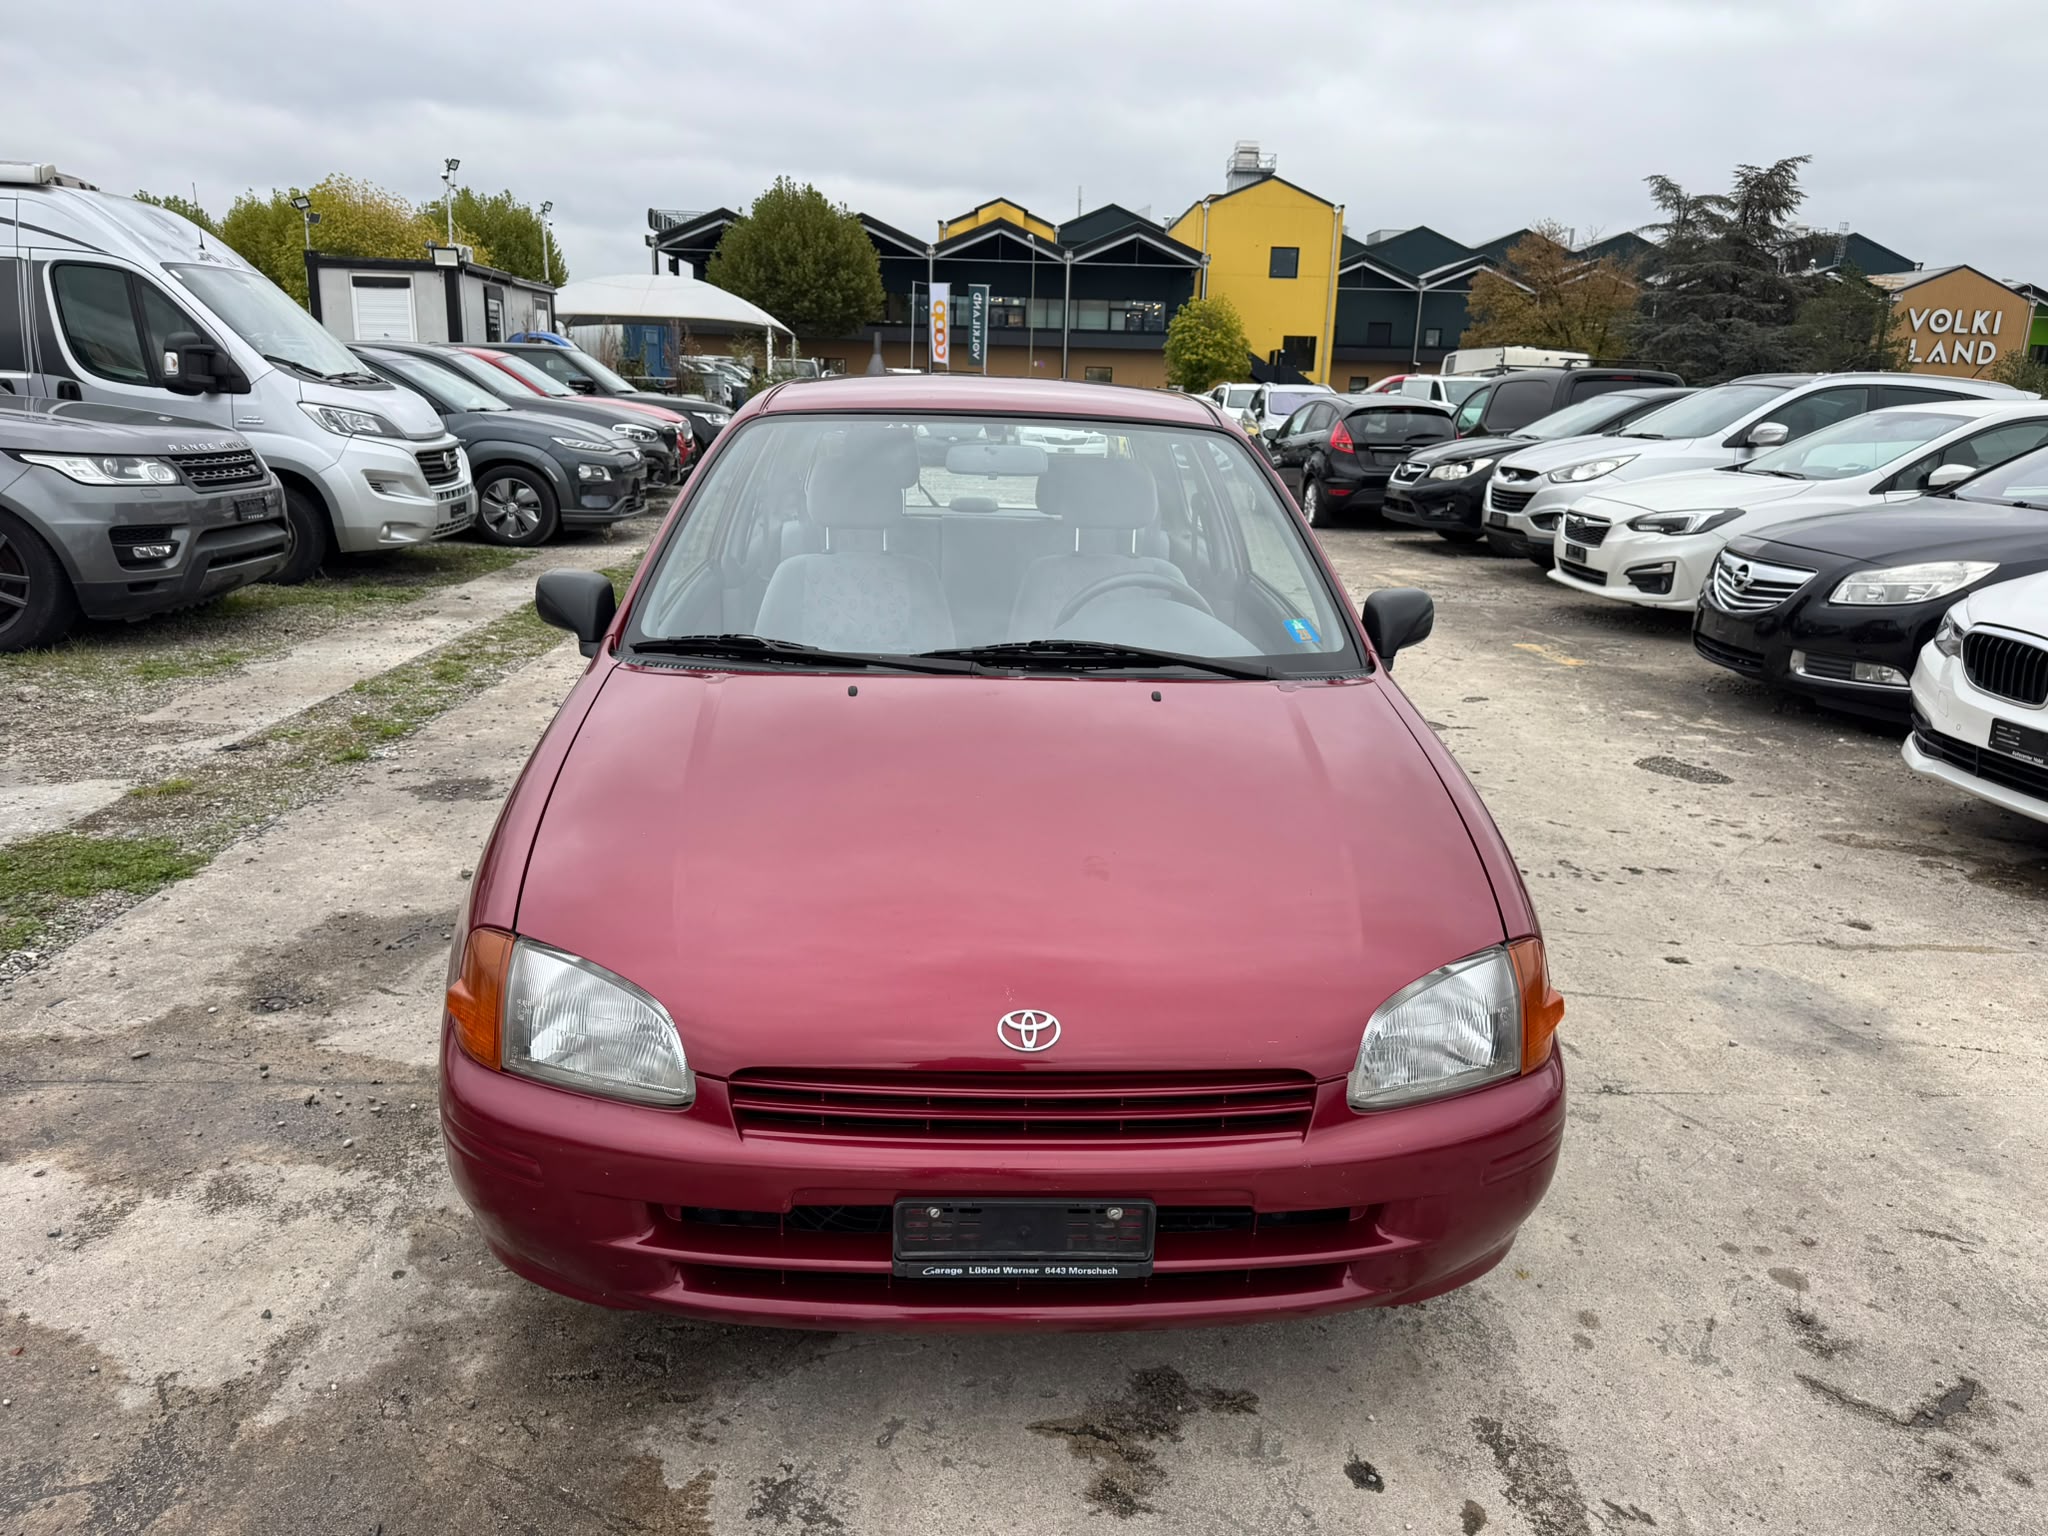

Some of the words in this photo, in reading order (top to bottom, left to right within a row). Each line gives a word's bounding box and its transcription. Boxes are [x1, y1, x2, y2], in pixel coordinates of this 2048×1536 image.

[1908, 307, 2003, 335] VOLKI
[1907, 338, 1997, 365] LAND
[167, 442, 216, 453] RANGE
[922, 1266, 963, 1276] Garage
[1003, 1266, 1039, 1275] Werner
[1045, 1266, 1067, 1275] 6443
[1068, 1266, 1118, 1275] Morschach
